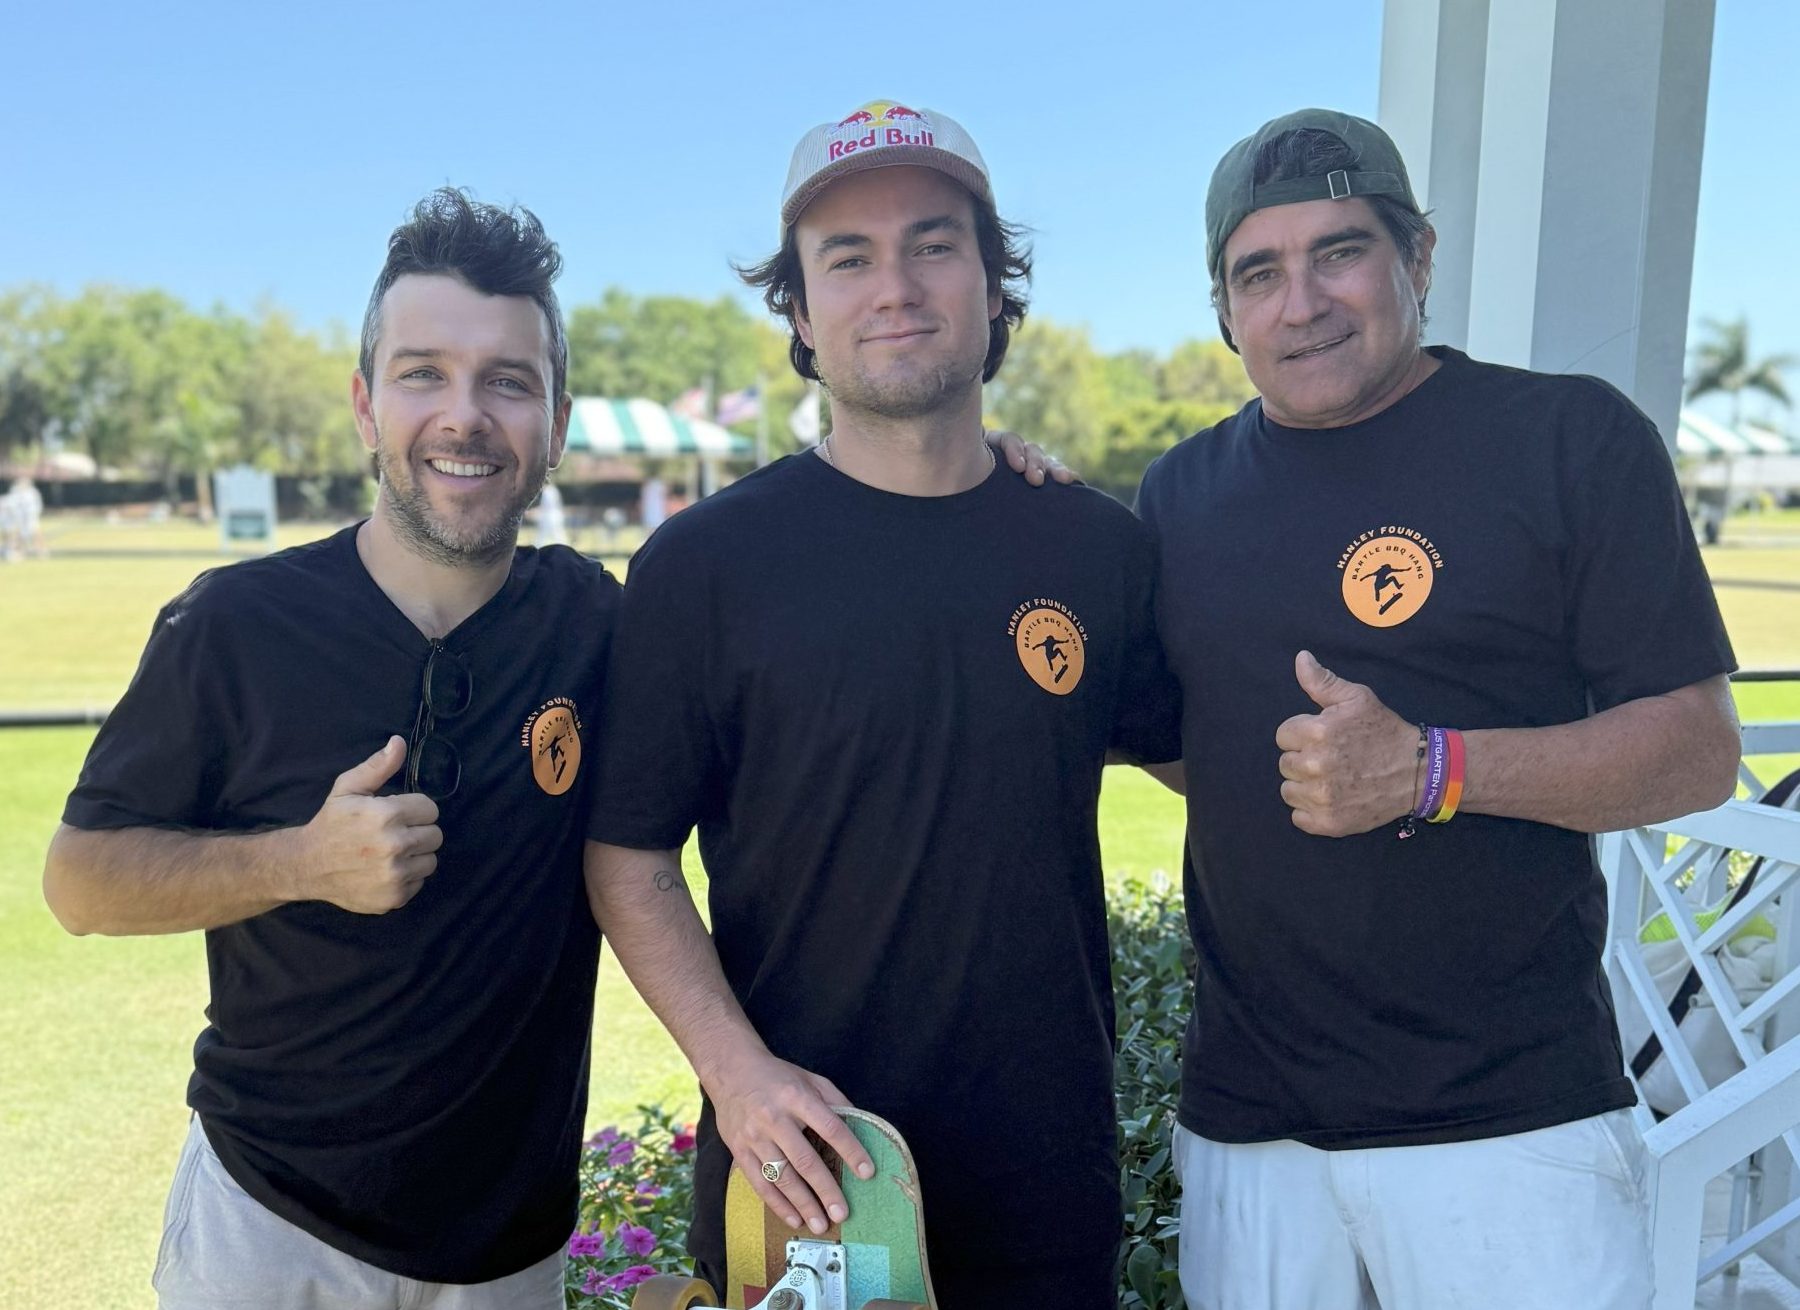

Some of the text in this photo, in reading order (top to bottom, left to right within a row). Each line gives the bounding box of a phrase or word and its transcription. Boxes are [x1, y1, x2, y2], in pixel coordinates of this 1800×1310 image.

[829, 128, 934, 162] Red Bull
[1337, 525, 1444, 570] HANLEY FOUNDATION
[1352, 545, 1424, 580] BARTLE BBQ HANG
[1007, 598, 1089, 642] HANLEY FOUNDATION
[1024, 618, 1041, 649] BARTLE
[1044, 617, 1061, 627] BBQ
[521, 711, 539, 747] HANLEY
[1433, 728, 1443, 788] LUSTGARTEN
